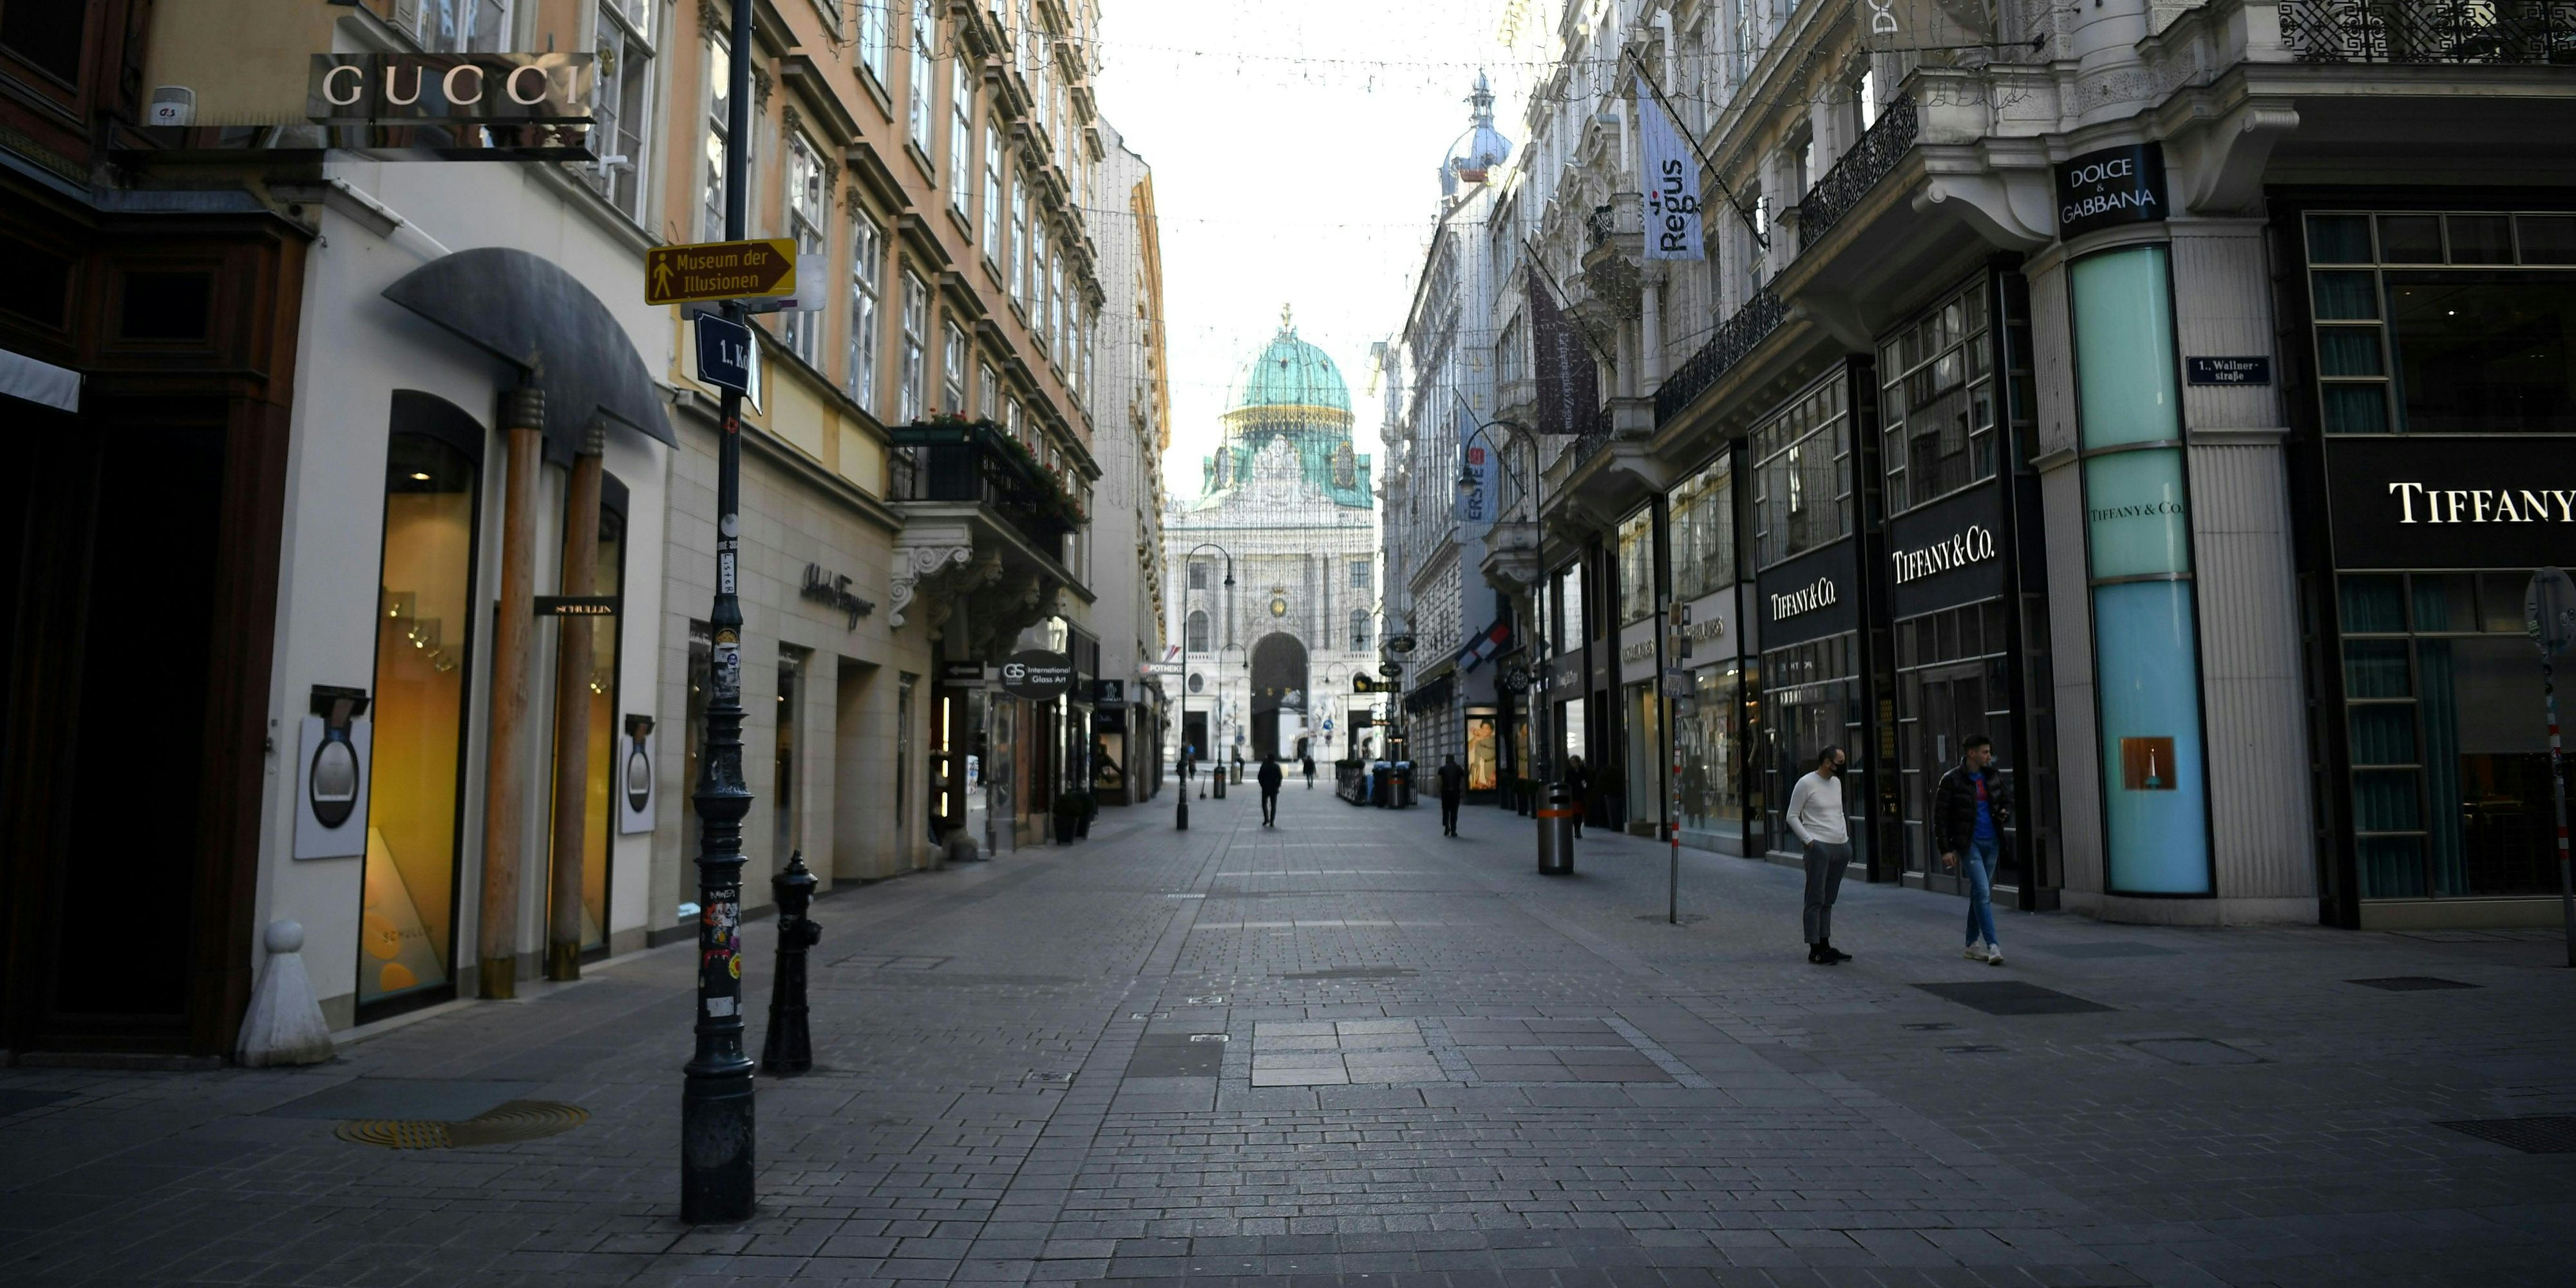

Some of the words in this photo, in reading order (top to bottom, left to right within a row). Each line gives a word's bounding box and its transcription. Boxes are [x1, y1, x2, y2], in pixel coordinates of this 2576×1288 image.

[323, 64, 578, 106] GUCCI
[2070, 158, 2132, 188] DOLCE
[2096, 183, 2105, 192] &
[1660, 160, 1696, 251] Regus
[2062, 189, 2156, 223] GABBANA
[677, 251, 738, 271] Museum
[744, 249, 768, 266] der
[684, 272, 759, 293] Illusionen
[735, 343, 750, 371] Ko
[2213, 361, 2259, 370] Wallner-
[2215, 371, 2244, 381] straße
[2090, 506, 2142, 522] TIFFANY
[2145, 504, 2155, 515] &
[2389, 482, 2576, 524] TIFFANY
[1005, 663, 1025, 678] GS
